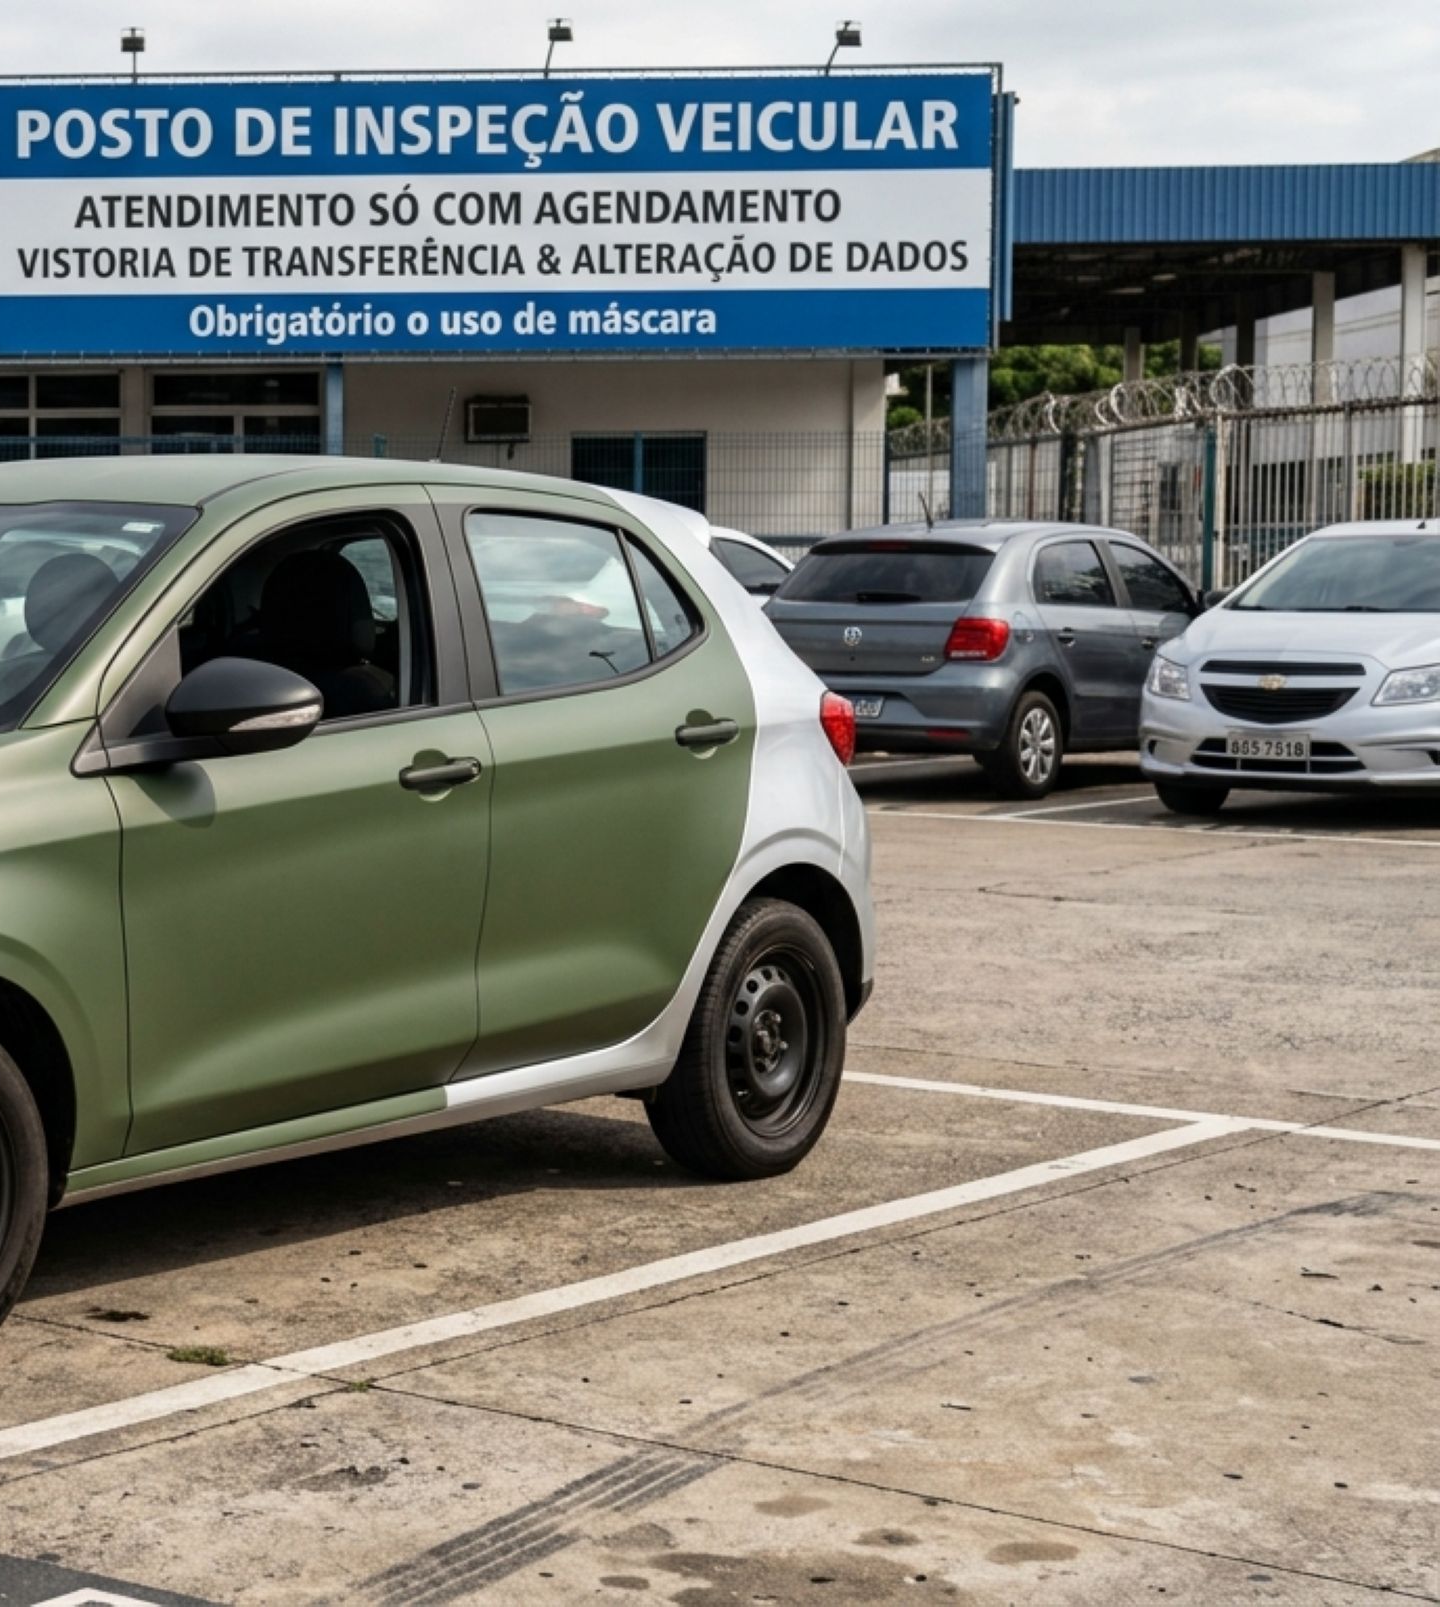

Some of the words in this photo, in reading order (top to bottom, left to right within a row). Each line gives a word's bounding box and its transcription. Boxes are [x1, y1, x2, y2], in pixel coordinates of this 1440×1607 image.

[16, 107, 213, 158] POSTO
[235, 107, 312, 156] DE
[335, 91, 639, 168] INSPEÇÃO
[655, 98, 961, 153] VEICULAR
[74, 191, 355, 228] ATENDIMENTO
[369, 182, 419, 226] SÓ
[434, 191, 522, 226] COM
[534, 188, 841, 226] AGENDAMENTO
[17, 246, 176, 279] VISTORIA
[189, 247, 232, 277] DE
[241, 236, 525, 277] TRANSFERÊNCIA
[537, 243, 562, 275] &
[571, 234, 776, 283] ALTERAÇÃO
[789, 242, 833, 273] DE
[846, 240, 969, 273] DADOS
[188, 301, 396, 346] Obrigatório
[407, 311, 430, 336] o
[440, 310, 502, 335] uso
[513, 301, 558, 335] de
[569, 301, 717, 335] máscara
